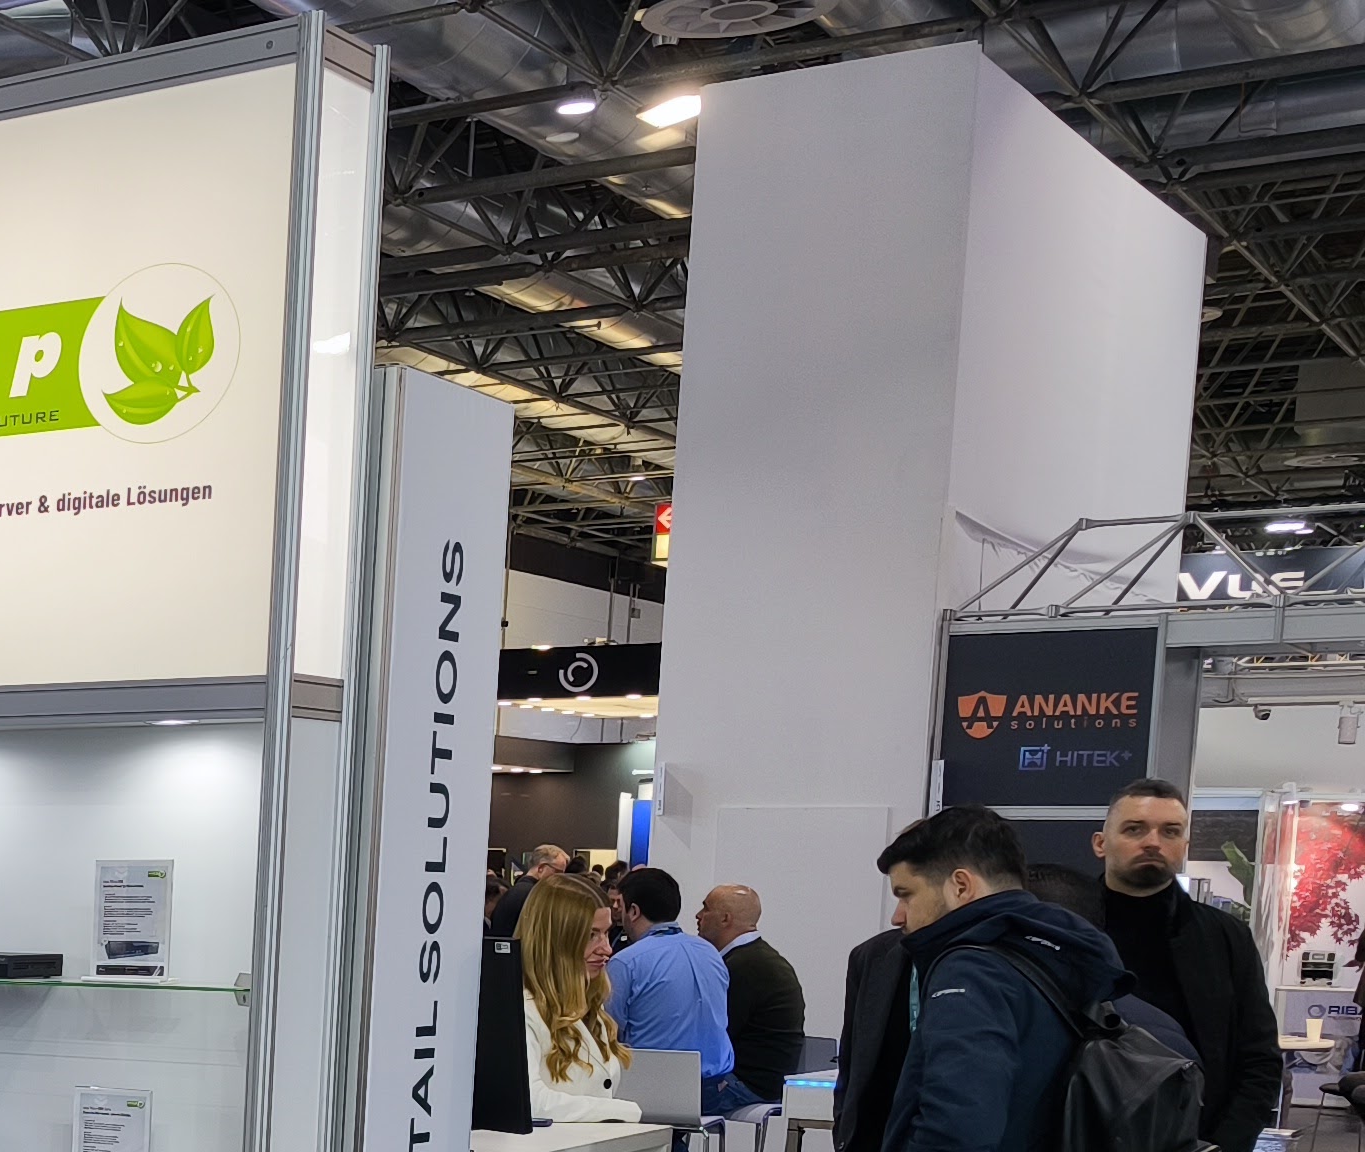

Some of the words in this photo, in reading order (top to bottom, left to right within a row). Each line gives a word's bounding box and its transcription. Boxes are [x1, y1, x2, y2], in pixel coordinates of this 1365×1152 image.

[38, 495, 50, 513] &
[56, 488, 121, 515] digitale
[127, 483, 213, 508] Lösungen
[1012, 692, 1139, 717] ANANKE
[1011, 717, 1137, 729] solutions
[418, 539, 464, 985] SOLUTIONS
[1328, 1006, 1361, 1015] RIB
